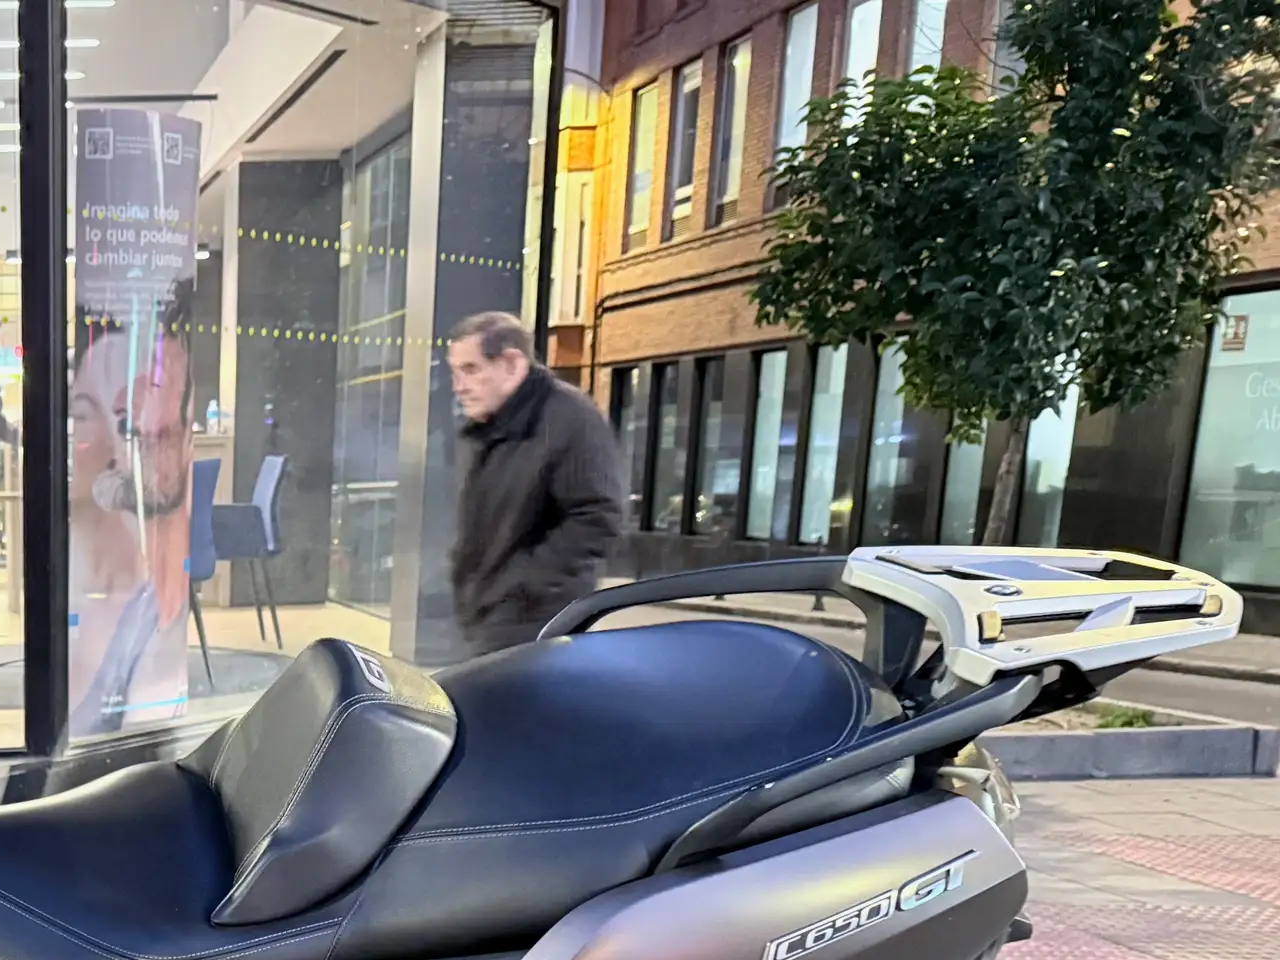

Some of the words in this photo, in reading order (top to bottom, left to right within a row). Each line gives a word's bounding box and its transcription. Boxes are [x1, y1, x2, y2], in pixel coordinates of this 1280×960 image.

[85, 224, 103, 242] lo
[109, 228, 136, 246] que
[85, 248, 148, 266] cambiar
[899, 850, 980, 911] GT
